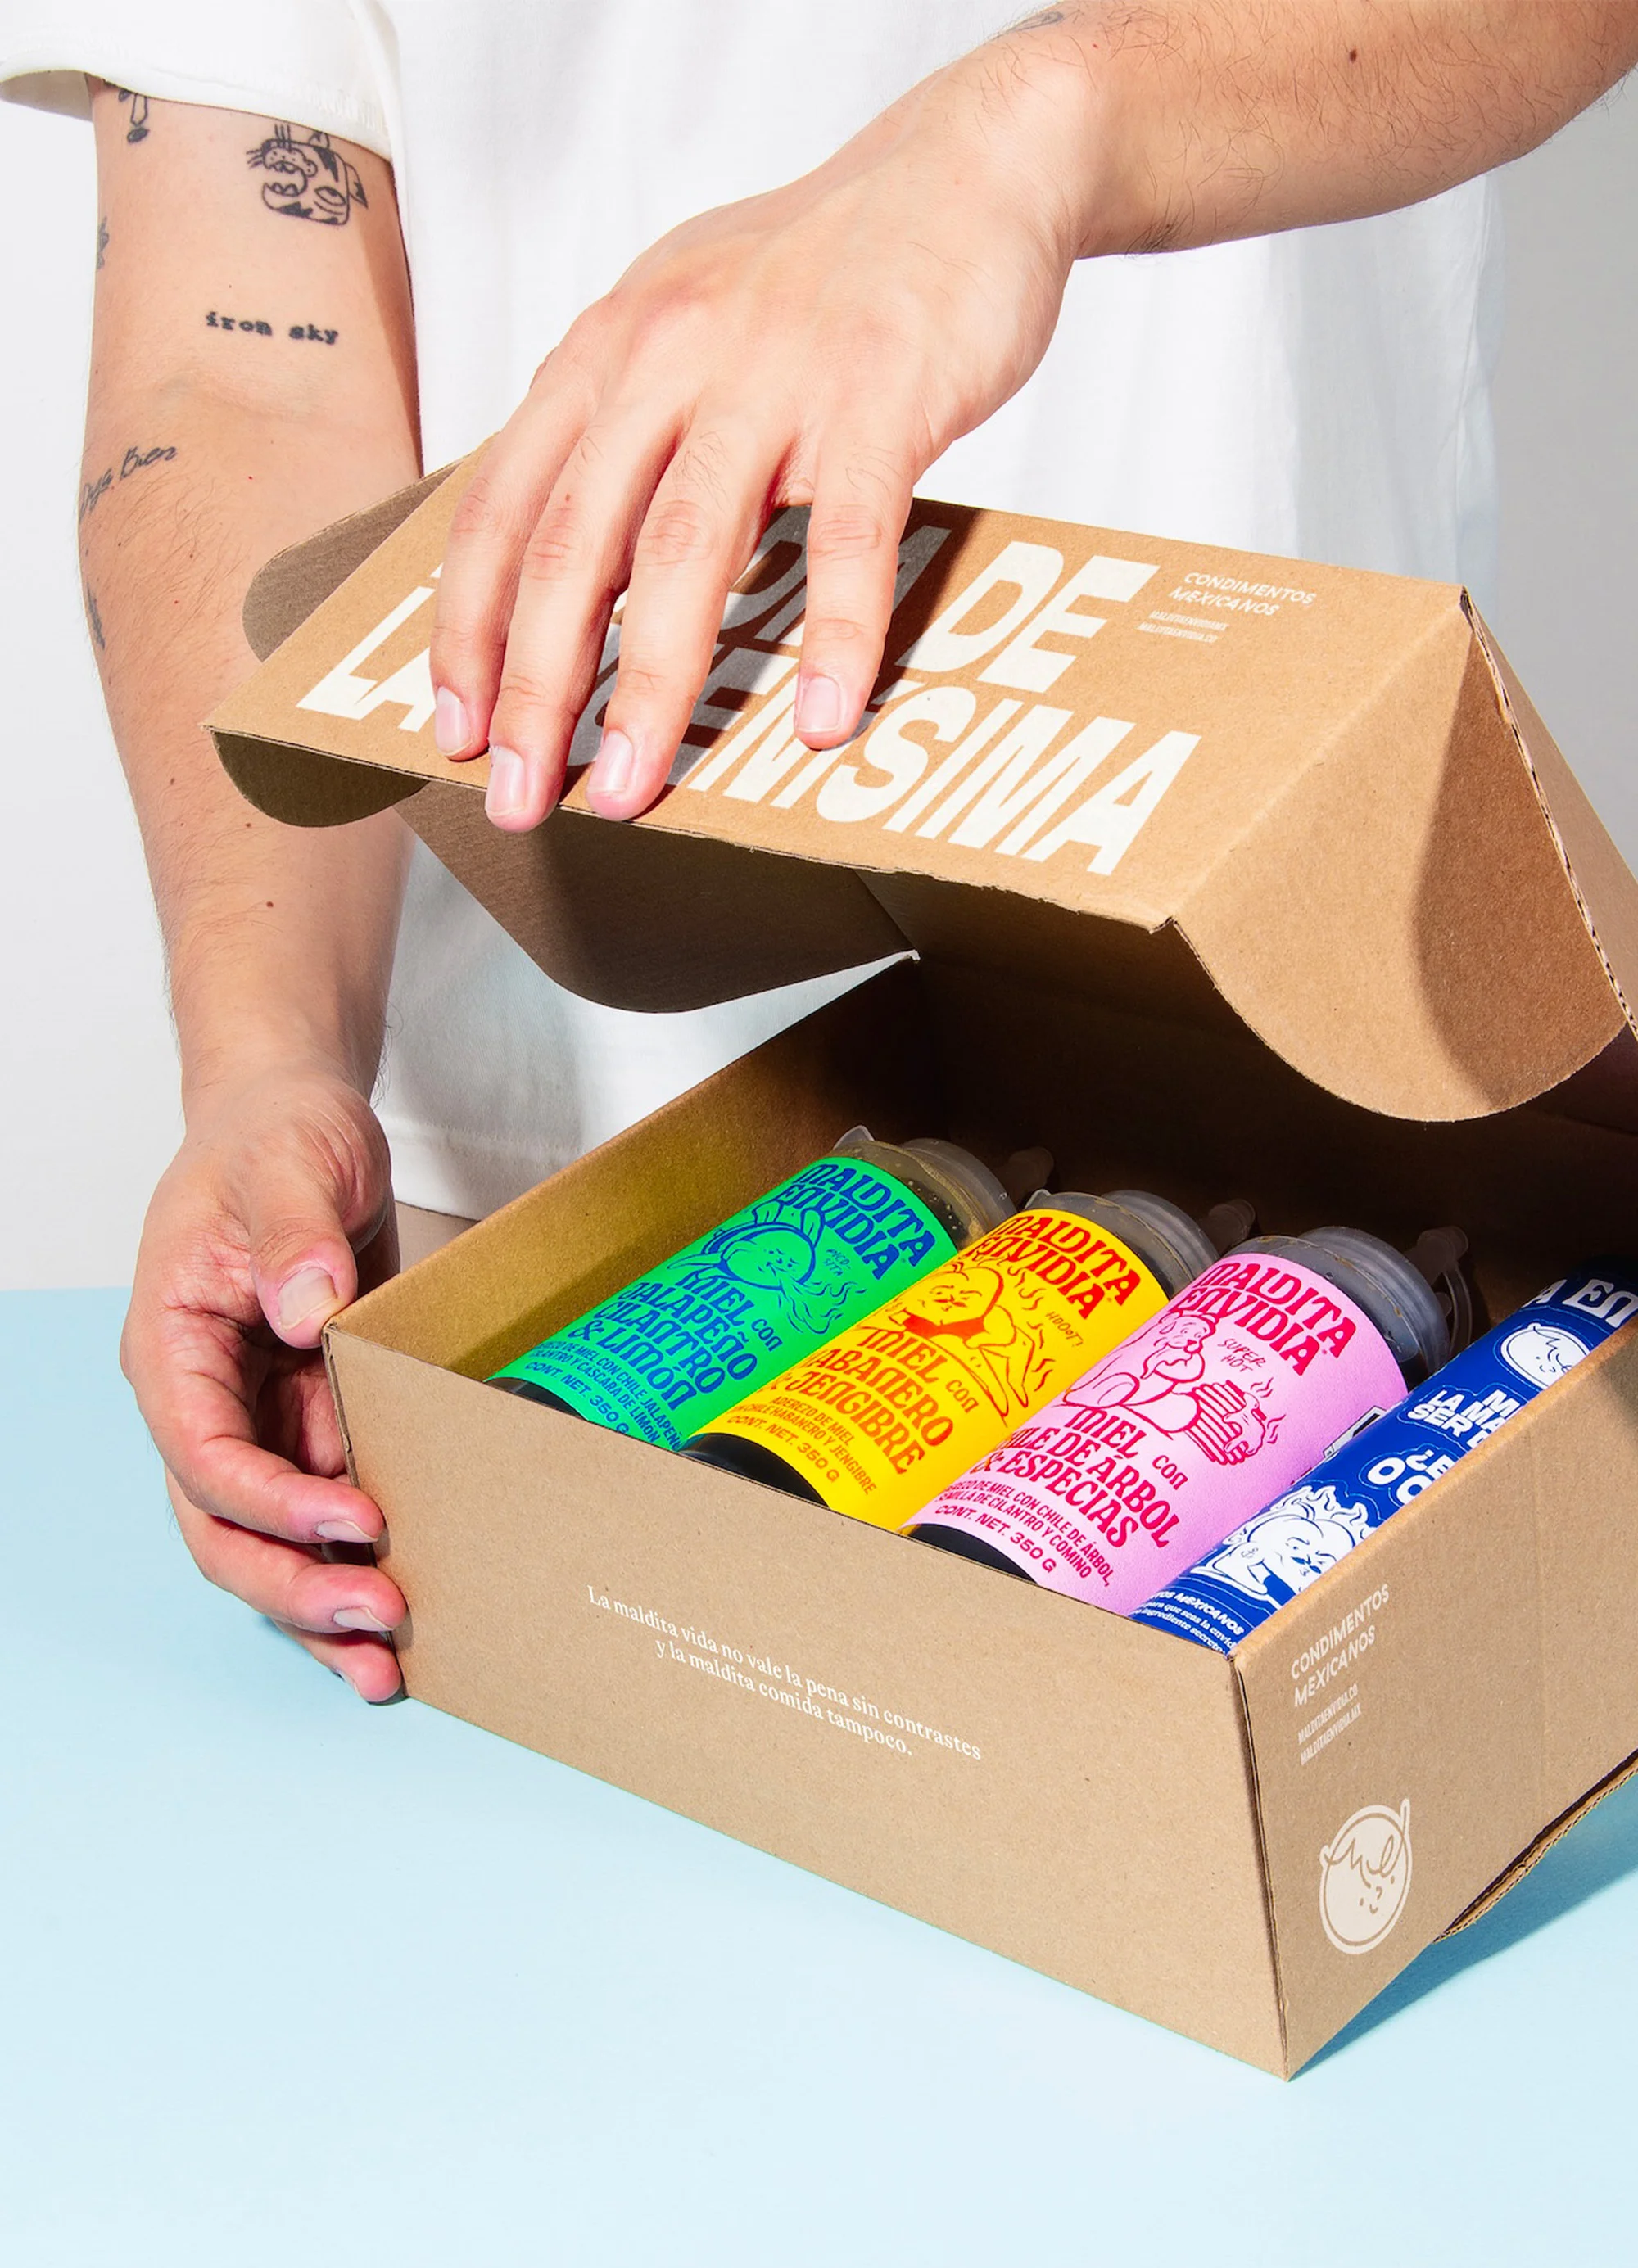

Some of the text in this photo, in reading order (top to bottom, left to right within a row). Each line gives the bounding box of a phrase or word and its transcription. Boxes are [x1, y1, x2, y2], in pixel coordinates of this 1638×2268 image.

[206, 311, 338, 345] iron sky
[894, 540, 1161, 694] DE
[1168, 585, 1280, 616] MEXICANOS
[1184, 572, 1317, 605] CONDIMENTOS
[773, 1184, 900, 1281] ENVIDIA
[792, 1163, 936, 1267] MALDITA
[972, 1236, 1105, 1320] ENVIDIA
[989, 1215, 1141, 1306] MALDITA
[675, 1269, 754, 1327] MIEL
[1192, 1262, 1356, 1359] MALDITA
[594, 1301, 726, 1394] CILANTRO
[618, 1281, 758, 1380] JALAPEÑO
[857, 1329, 948, 1384] MIEL
[1170, 1286, 1320, 1376] ENVIDIA
[1217, 1338, 1267, 1368] SUPER
[568, 1319, 698, 1412] & LIMÓN
[596, 1357, 622, 1377] CON
[615, 1371, 649, 1400] CHILE
[1220, 1355, 1254, 1373] HOT
[560, 1373, 592, 1398] NET.
[590, 1394, 620, 1423] 350
[617, 1394, 636, 1409] DE
[784, 1370, 925, 1475] JENGIBRE
[813, 1412, 834, 1427] DE
[827, 1421, 855, 1447] MIEL
[1407, 1403, 1473, 1438] SER
[1428, 1389, 1465, 1412] LA
[766, 1423, 799, 1446] NET.
[797, 1442, 829, 1470] 350
[826, 1468, 840, 1484] G
[823, 1434, 836, 1447] Y
[1064, 1407, 1147, 1459] MIEL
[829, 1444, 877, 1495] JENGIBRE
[970, 1449, 1139, 1548] & ESPECIAS
[1046, 1431, 1101, 1466] DE
[1086, 1454, 1180, 1548] ÁRBOL
[934, 1504, 1057, 1574] CONT. NET. 350 G
[987, 1497, 1045, 1532] CILANTRO
[1042, 1526, 1055, 1538] Y
[1049, 1534, 1093, 1579] COMINO
[988, 1482, 1016, 1499] MIEL
[1013, 1491, 1042, 1511] CON
[1037, 1504, 1072, 1534] CHILE
[1066, 1527, 1087, 1545] DE
[1164, 1603, 1183, 1615] que
[1181, 1610, 1202, 1624] seas
[1200, 1620, 1210, 1630] la
[1174, 1592, 1245, 1636] MEXICANOS
[1291, 1583, 1390, 1680] CONDIMENTOS
[586, 1584, 981, 1760] La maldita vida no vale la pena sin contrastes
[1294, 1624, 1376, 1708] MEXICANOS
[655, 1640, 913, 1756] y la maldita comida tampoco.
